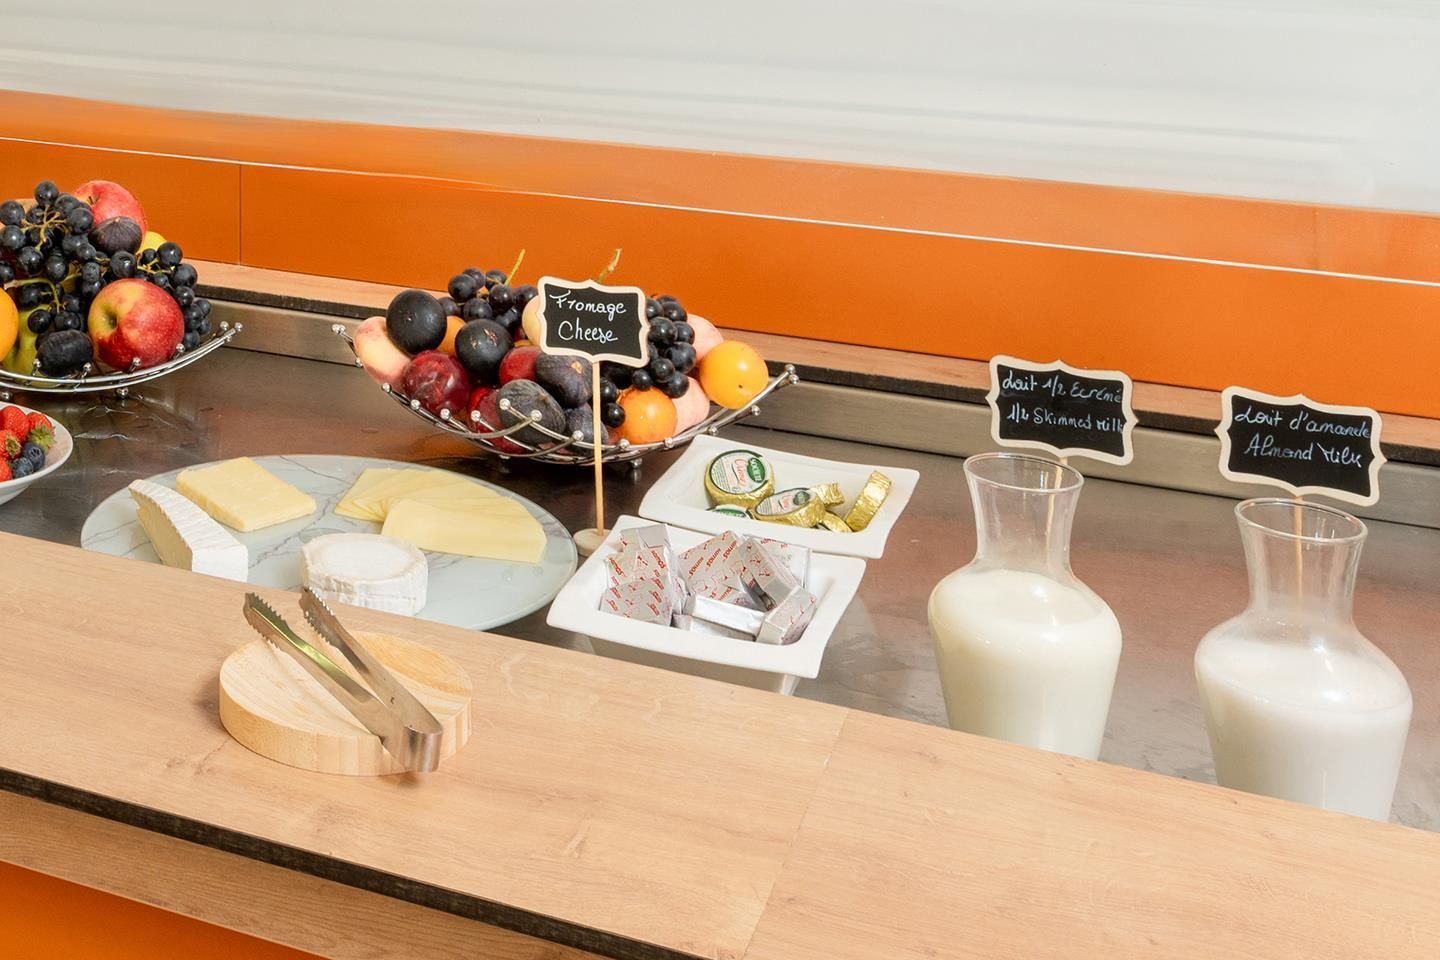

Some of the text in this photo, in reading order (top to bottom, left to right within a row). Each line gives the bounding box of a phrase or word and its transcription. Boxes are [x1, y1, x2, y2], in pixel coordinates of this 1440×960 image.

[549, 289, 627, 322] Fromage
[558, 317, 618, 344] Cheese
[1041, 375, 1066, 397] 1/2
[1006, 402, 1029, 424] 1/2
[1033, 407, 1092, 430] Skimmed
[1289, 410, 1371, 439] d'amande
[1244, 433, 1314, 461] Almond
